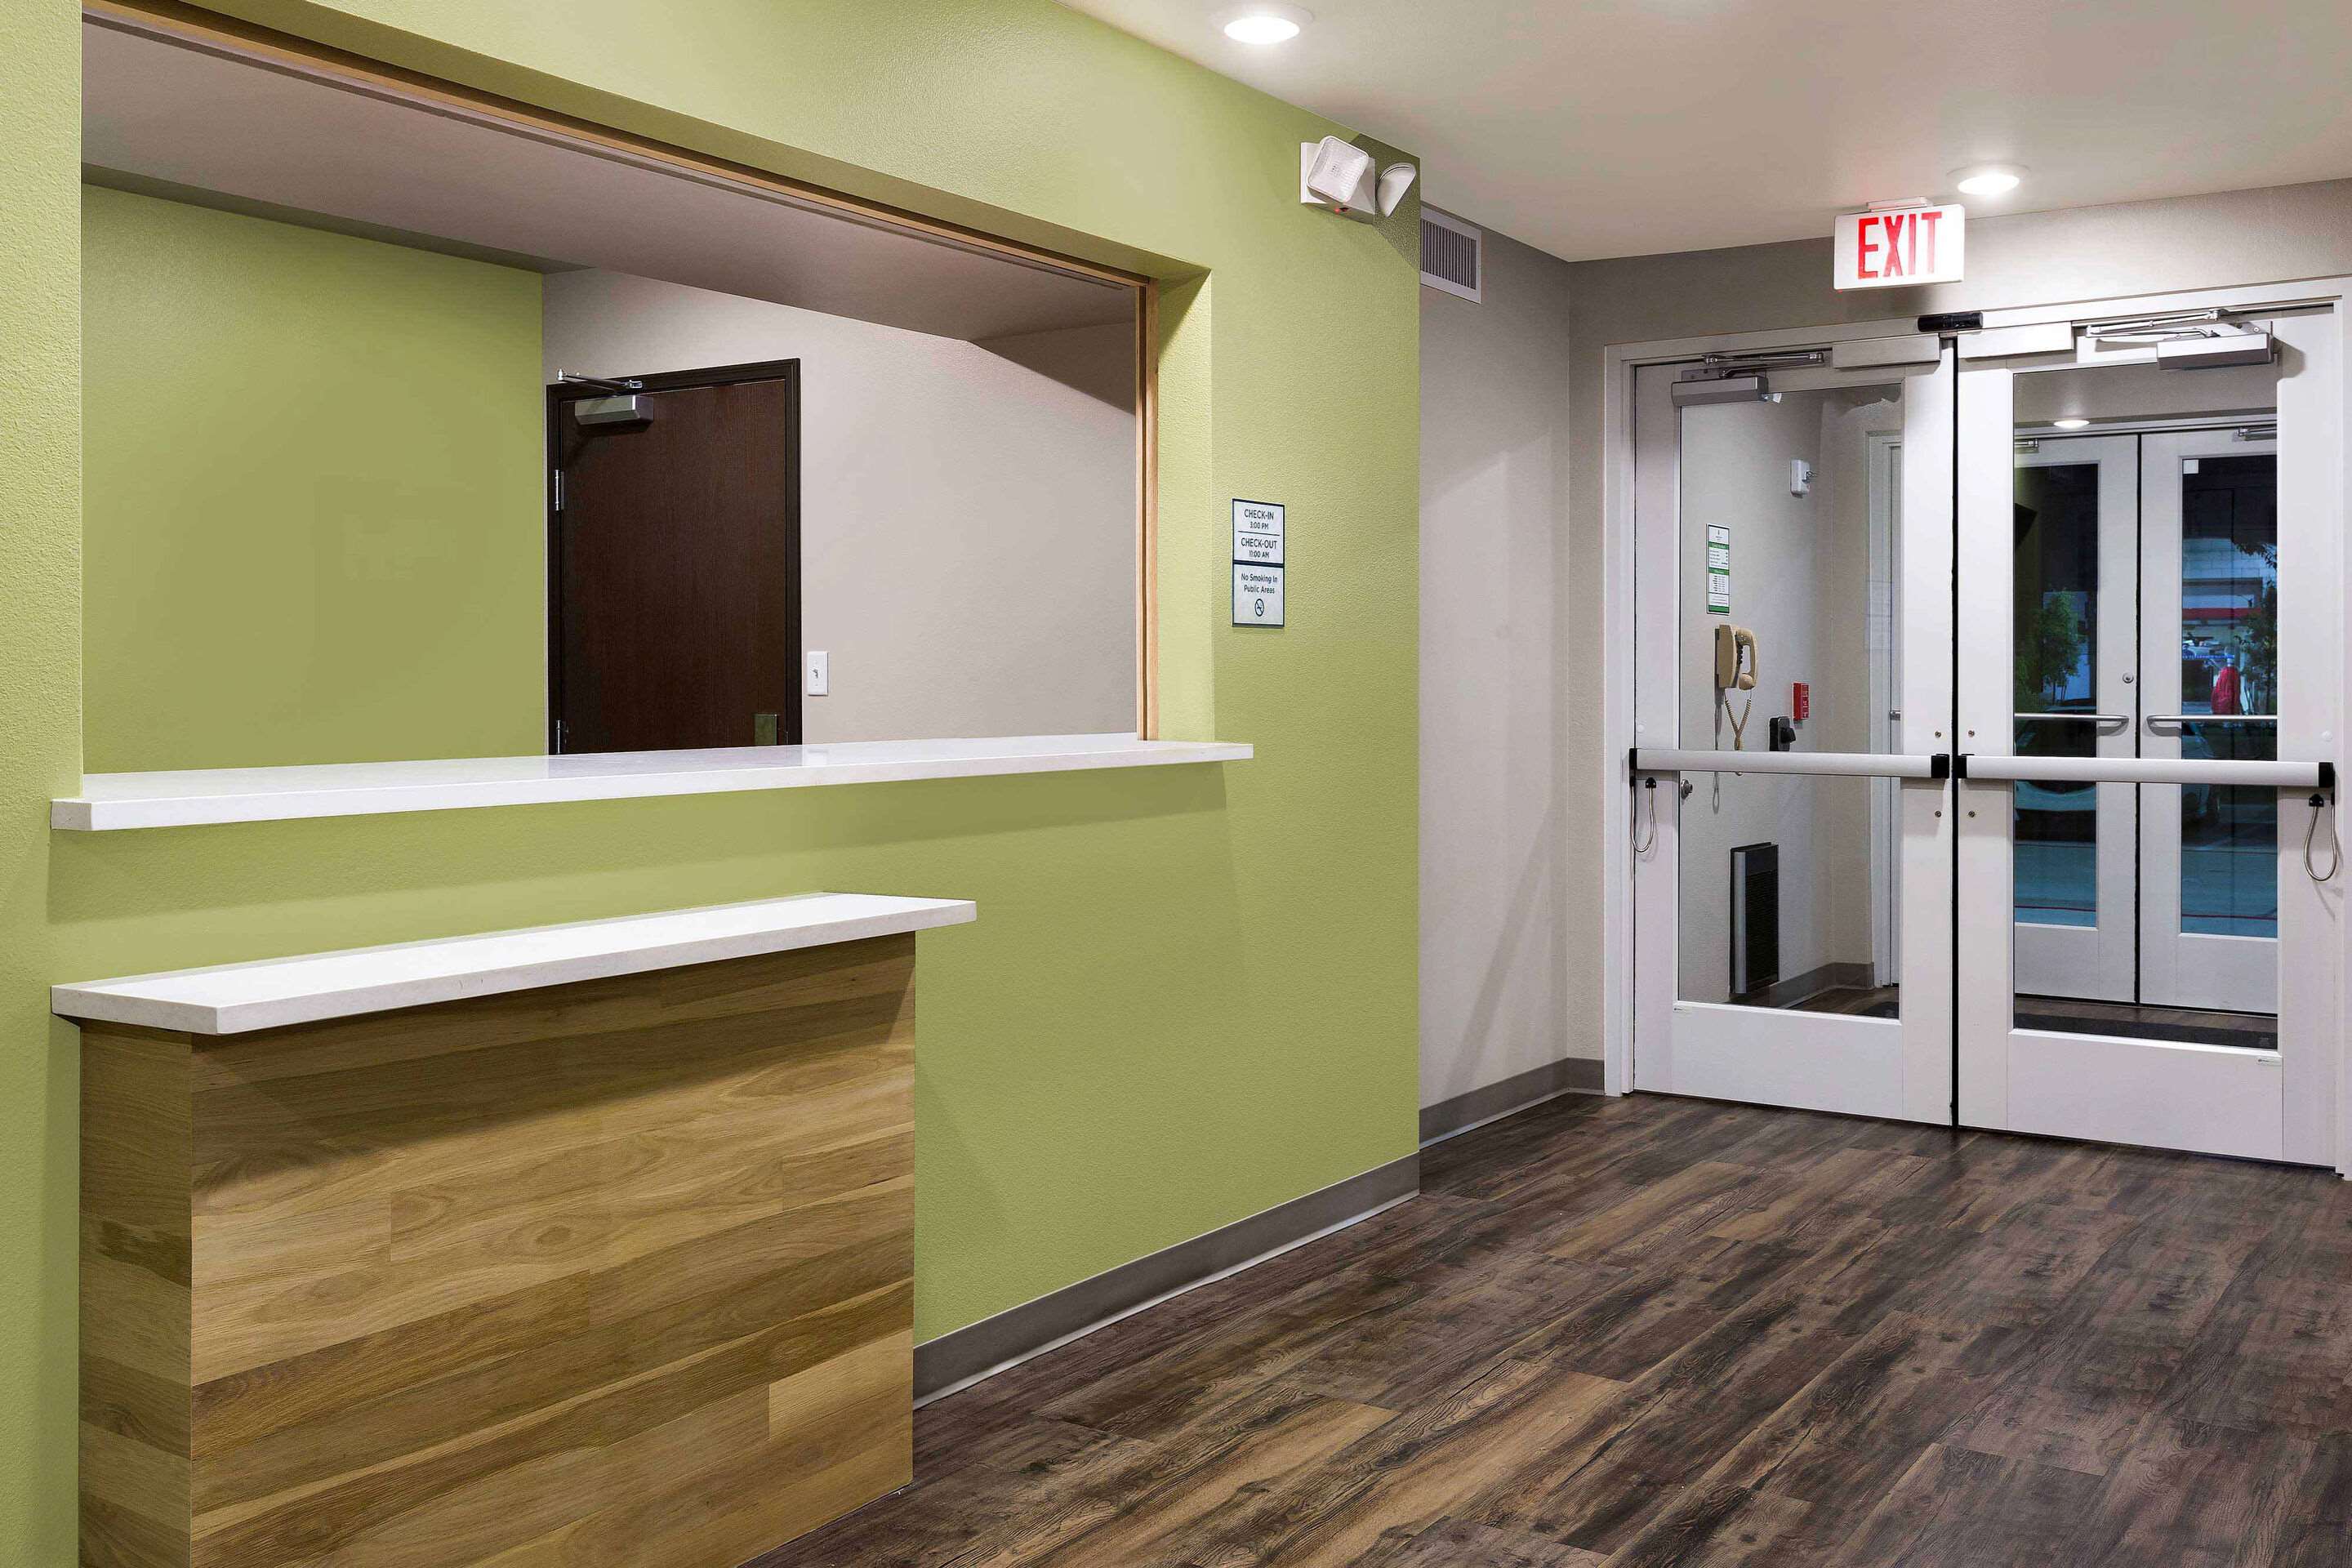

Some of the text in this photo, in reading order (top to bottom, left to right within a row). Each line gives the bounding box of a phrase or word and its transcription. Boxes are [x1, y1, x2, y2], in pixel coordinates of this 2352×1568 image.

[1858, 211, 1942, 279] EXIT
[1244, 509, 1274, 520] CHECK-IN
[1241, 537, 1277, 549] CHECK-OUT
[1250, 574, 1272, 584] Smoking
[1272, 575, 1278, 583] In
[1244, 585, 1275, 595] Public Areas
